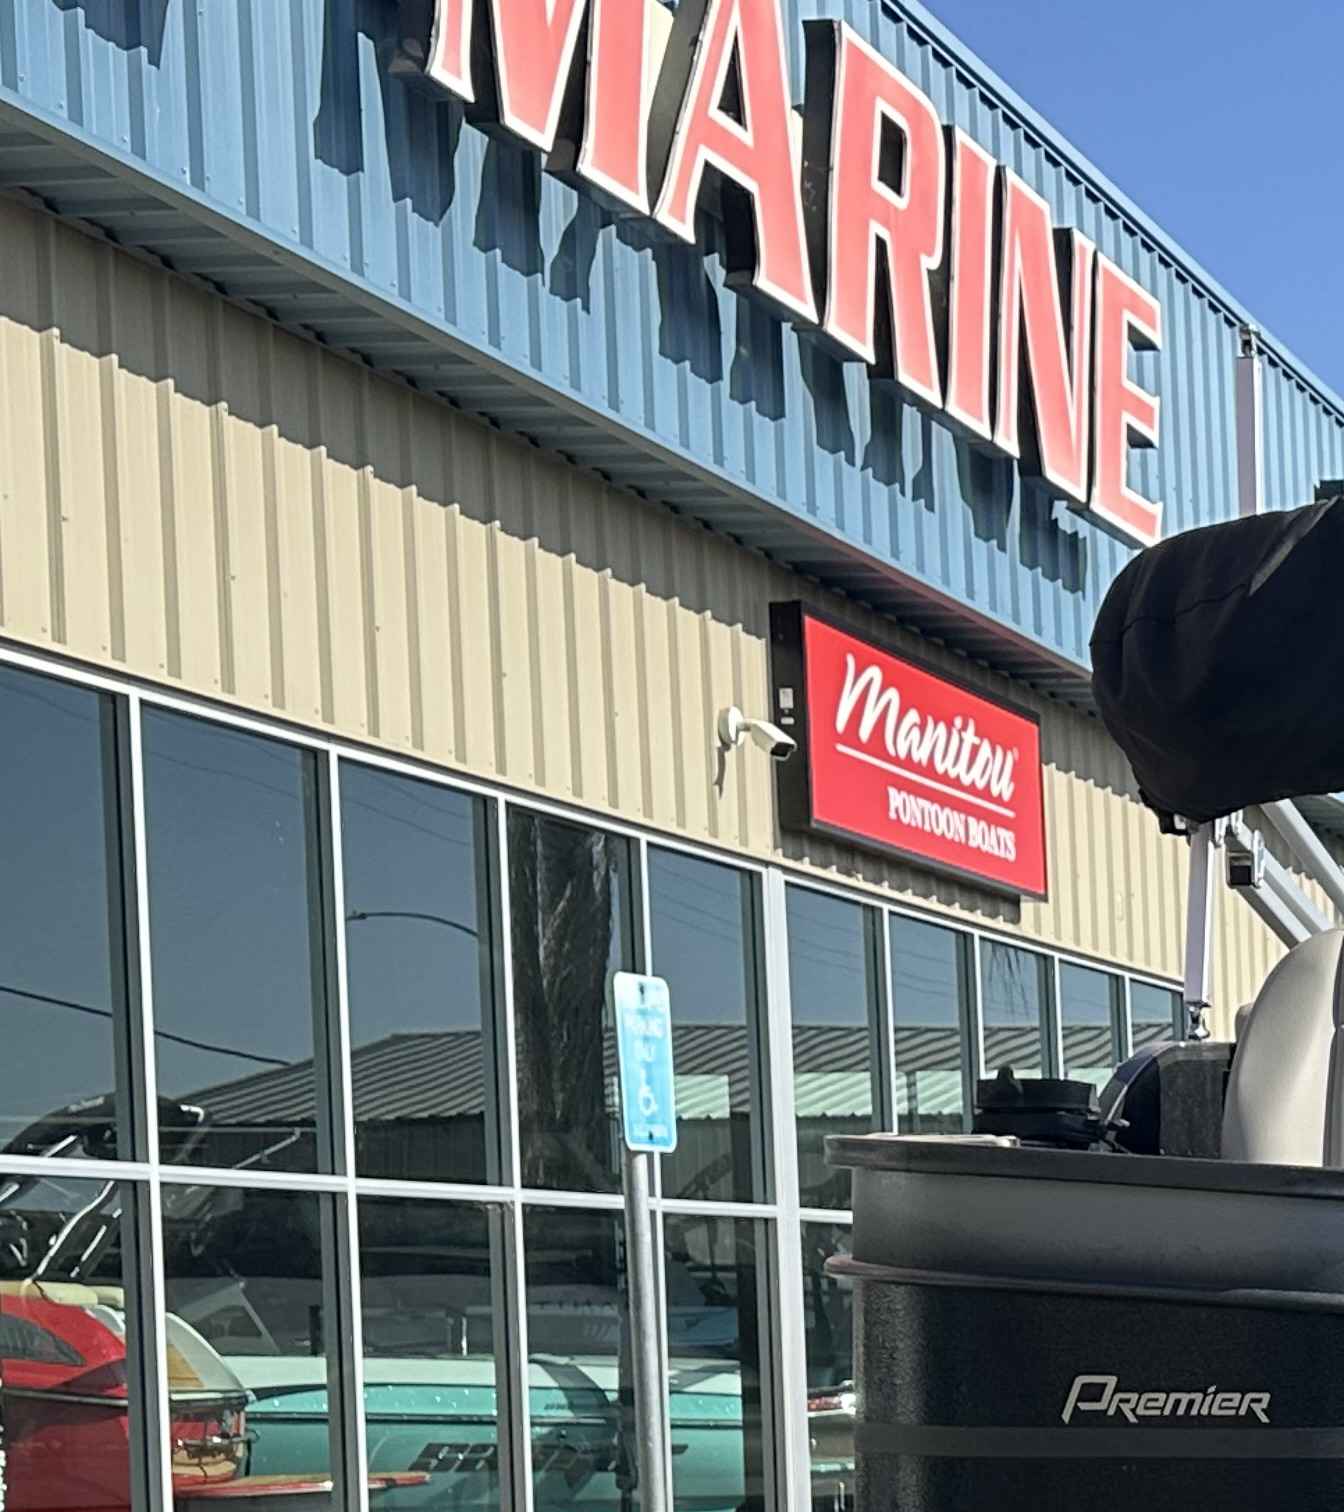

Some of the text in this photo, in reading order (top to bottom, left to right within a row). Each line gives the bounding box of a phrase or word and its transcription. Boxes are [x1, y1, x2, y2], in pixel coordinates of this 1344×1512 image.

[835, 652, 1016, 802] Manitou
[886, 785, 1017, 863] PONTOON BOATS
